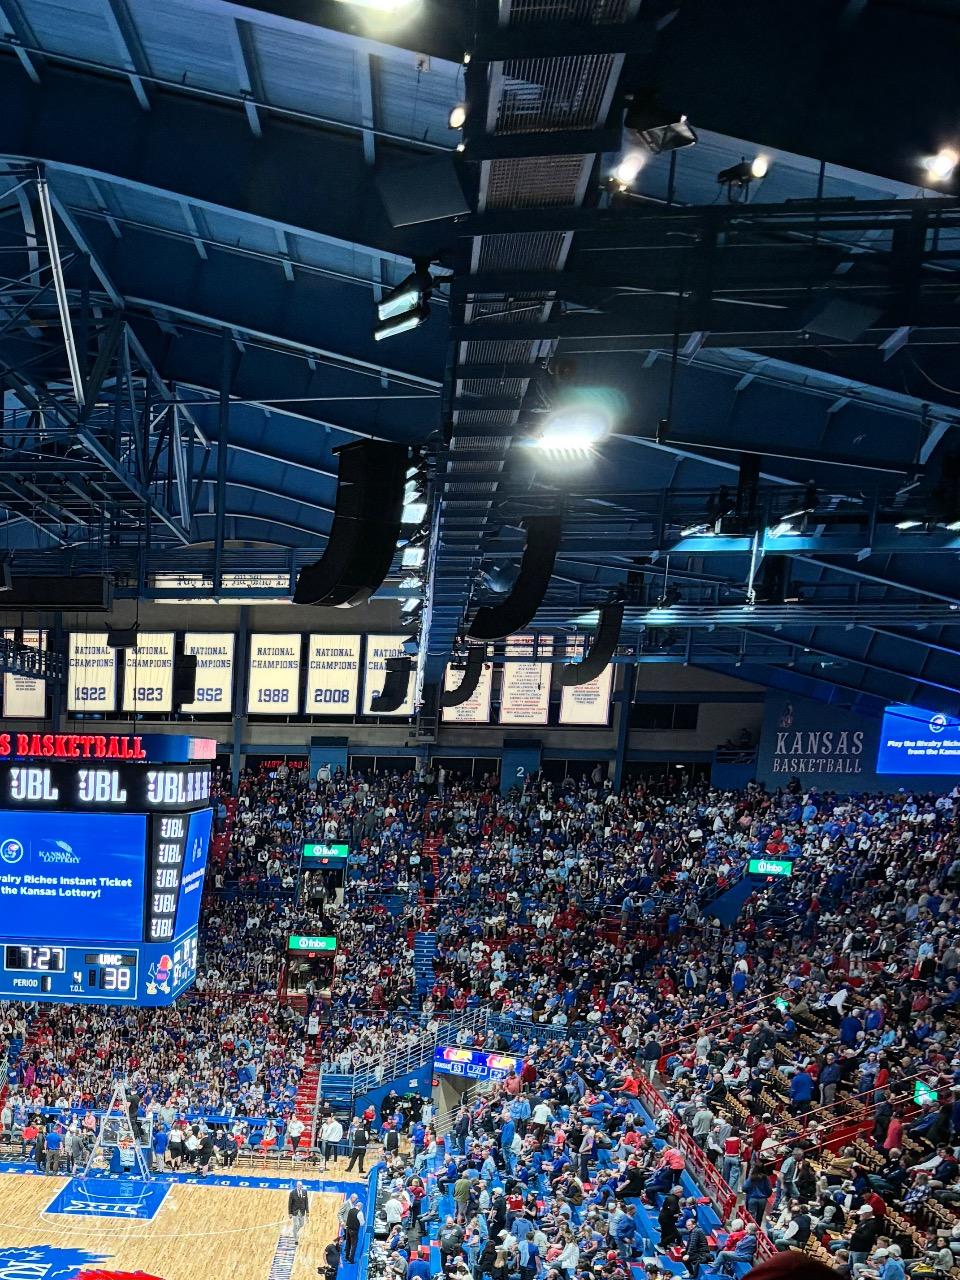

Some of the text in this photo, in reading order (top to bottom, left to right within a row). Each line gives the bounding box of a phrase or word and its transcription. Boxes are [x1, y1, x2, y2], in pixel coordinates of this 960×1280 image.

[75, 646, 111, 655] NATIONAL
[132, 646, 168, 655] NATIONAL
[190, 646, 228, 656] NATIONAL
[257, 647, 295, 656] NATIONAL
[315, 648, 354, 657] NATIONAL
[69, 658, 114, 668] CHAMPIONS
[126, 658, 172, 668] CHAMPIONS
[196, 659, 231, 668] AMPIONS
[251, 660, 298, 669] CHAMPIONS
[310, 661, 357, 670] CHAMPIONS
[76, 686, 106, 701] 1922
[132, 687, 163, 701] 1923
[196, 687, 223, 702] 952
[257, 688, 289, 703] 1988
[314, 689, 350, 703] 2008
[16, 734, 147, 760] BASKETBALL
[774, 731, 864, 755] KANSAS
[516, 766, 525, 777] 2
[772, 758, 862, 773] BASKETBALL
[10, 768, 59, 801] JBL
[78, 769, 127, 802] JBL
[147, 770, 186, 803] JBL
[161, 818, 184, 838] JBL
[159, 844, 181, 863] JBL
[24, 874, 57, 884] Riches
[60, 876, 97, 886] Instant
[99, 877, 132, 887] Ticket
[156, 869, 178, 888] JBL
[1, 885, 18, 894] the
[20, 886, 56, 896] Kansas
[59, 888, 101, 899] Lottery!
[154, 894, 176, 913] JBL
[151, 919, 173, 938] JBL
[21, 947, 63, 970] 7:27
[13, 979, 38, 988] PERIOD
[73, 971, 82, 984] 4
[104, 968, 131, 990] 38
[221, 1179, 312, 1190] COURT
